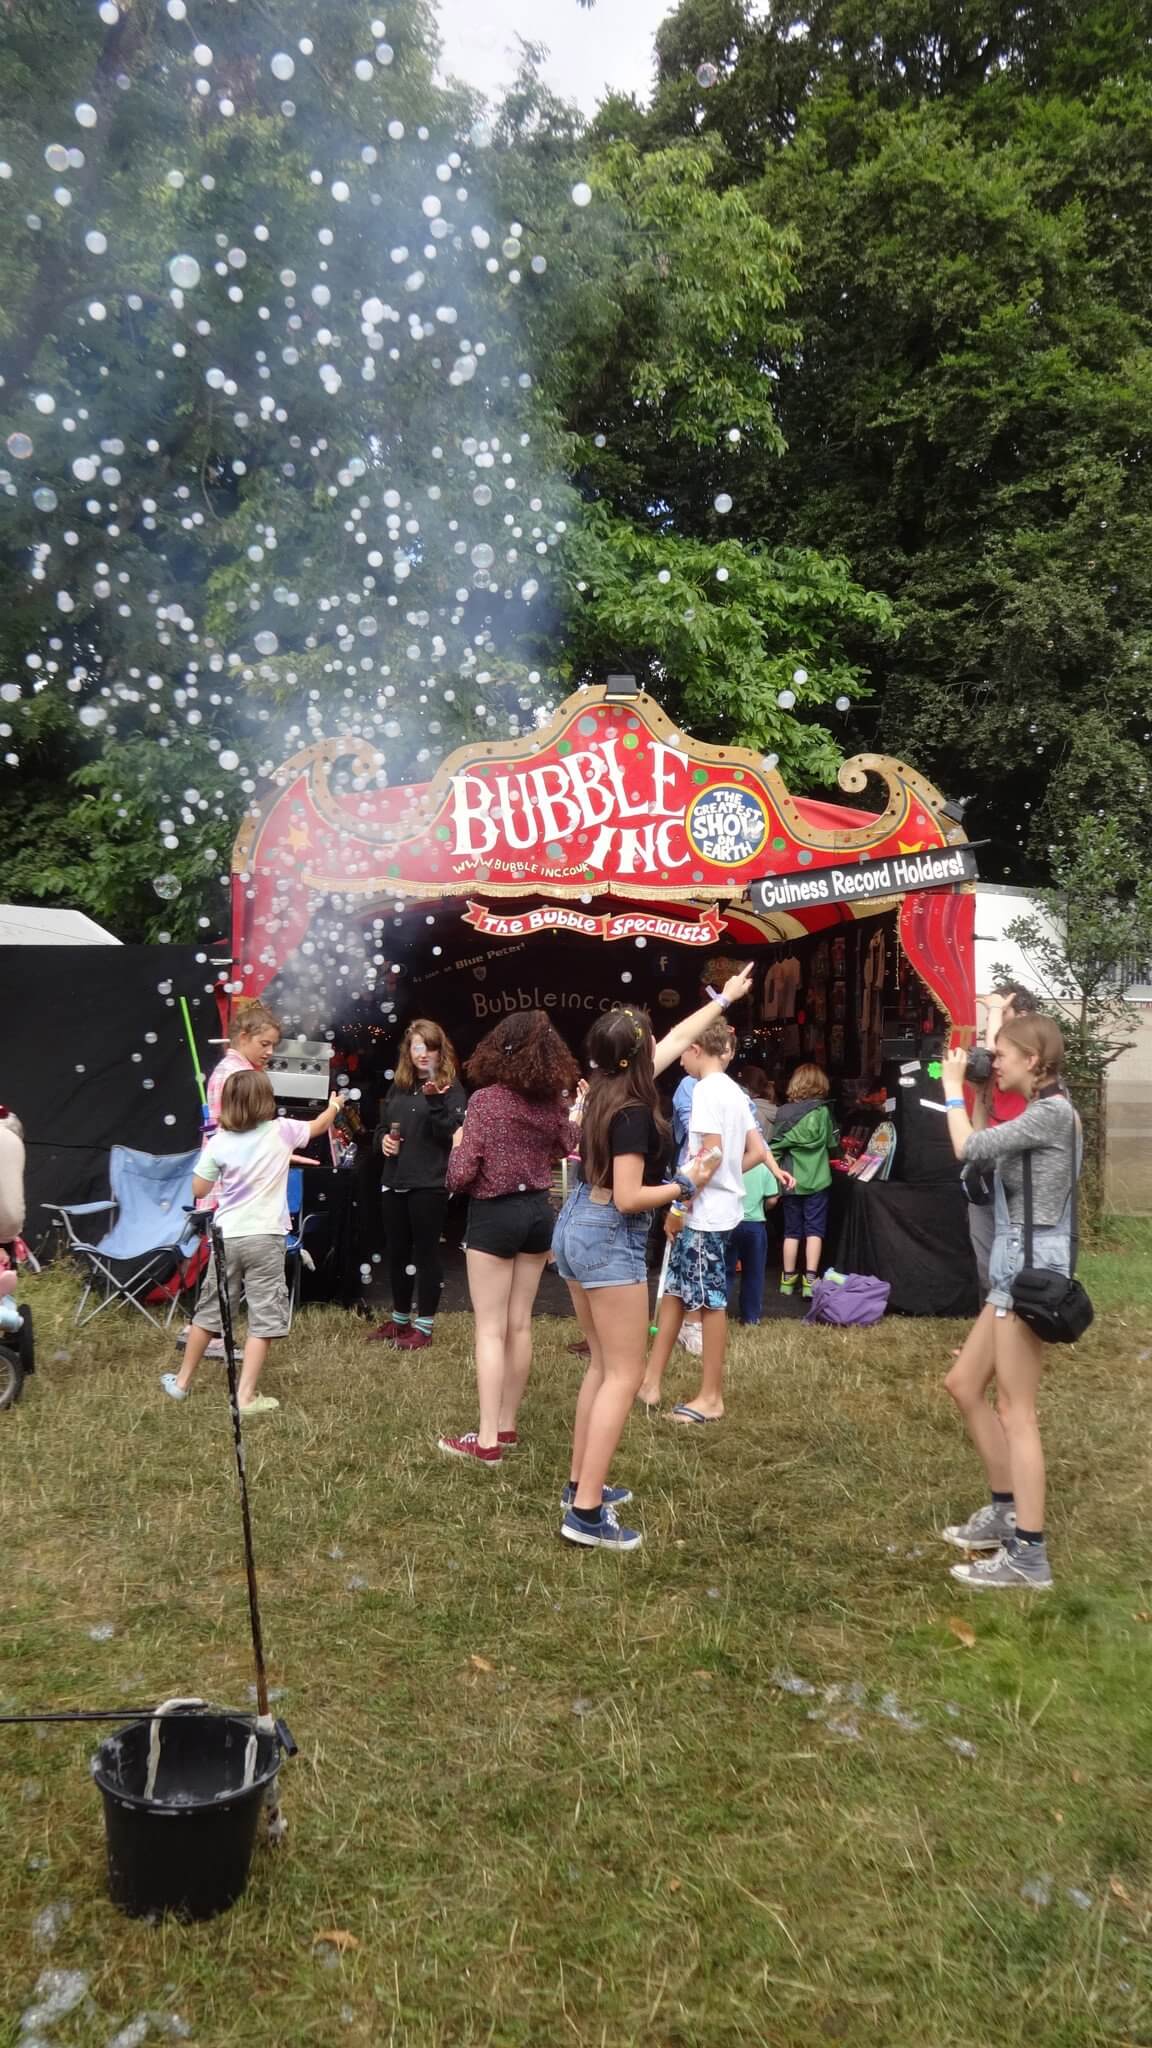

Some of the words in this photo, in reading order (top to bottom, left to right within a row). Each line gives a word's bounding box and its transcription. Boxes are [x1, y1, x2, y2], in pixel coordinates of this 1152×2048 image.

[448, 738, 689, 856] BUBBLE
[713, 790, 743, 805] THE
[694, 801, 762, 821] GREATEST
[692, 813, 765, 839] SHOW
[584, 818, 692, 874] INC
[703, 840, 753, 861] EARTH
[718, 835, 736, 847] ON
[761, 879, 828, 908] Guiness
[831, 862, 891, 896] Record
[893, 851, 965, 884] Holders!
[483, 917, 524, 933] The
[529, 911, 596, 931] Bubble
[455, 955, 485, 970] Blue
